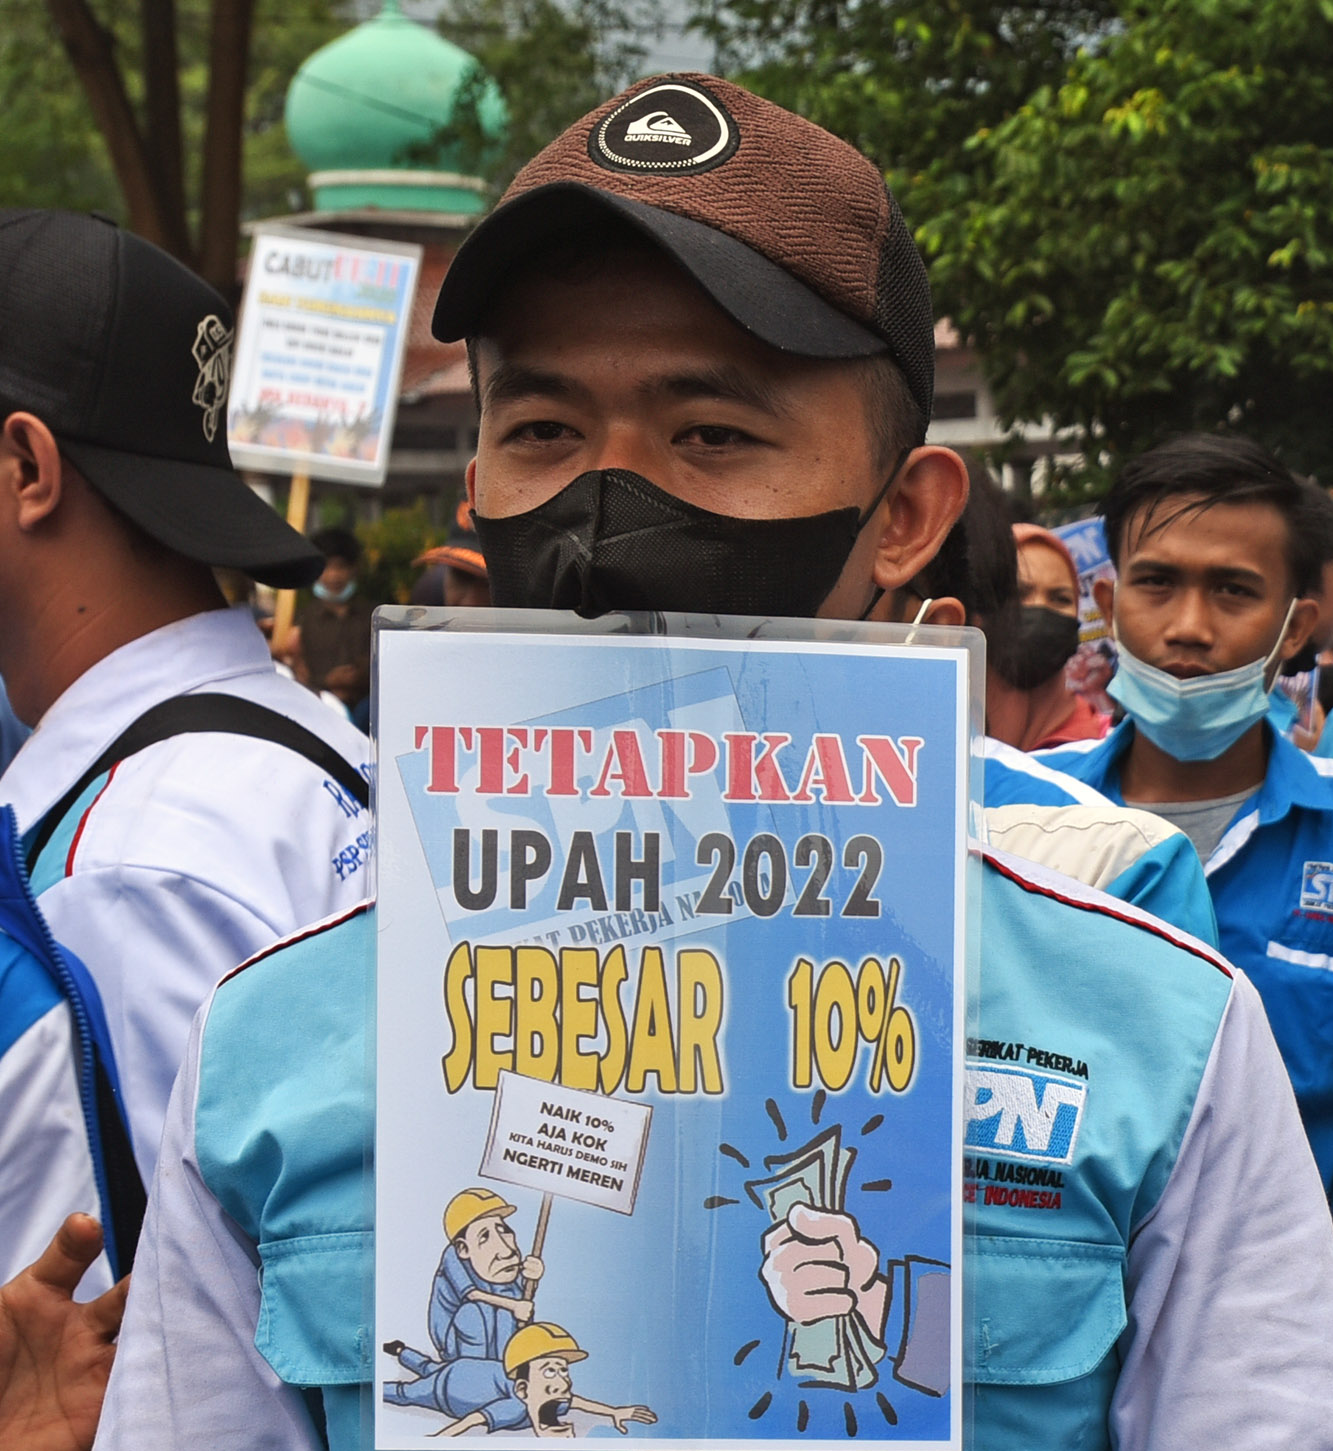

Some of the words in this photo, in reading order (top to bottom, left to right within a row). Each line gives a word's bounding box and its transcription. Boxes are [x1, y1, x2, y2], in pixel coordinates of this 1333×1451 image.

[624, 134, 692, 147] QUIKSILVER
[414, 725, 925, 807] TETAPKAN
[453, 828, 661, 914] UPAH
[695, 831, 884, 918] 2022
[442, 940, 725, 1095] SEBESAR
[789, 957, 916, 1095] 10%
[1027, 1047, 1089, 1080] PEKERJA
[540, 1102, 582, 1124] NAIK
[585, 1115, 615, 1133] 10%
[964, 1070, 1085, 1152] PN
[509, 1132, 534, 1147] KITA
[536, 1139, 574, 1157] HARUS
[575, 1150, 608, 1167] DEMO
[610, 1160, 628, 1172] SIH
[537, 1123, 566, 1142] AJA
[571, 1131, 608, 1152] KOK
[503, 1148, 564, 1176] NGERTI
[566, 1165, 624, 1192] MEREN
[996, 1161, 1065, 1188] NASIONAL
[984, 1186, 1062, 1210] INDONESIA
